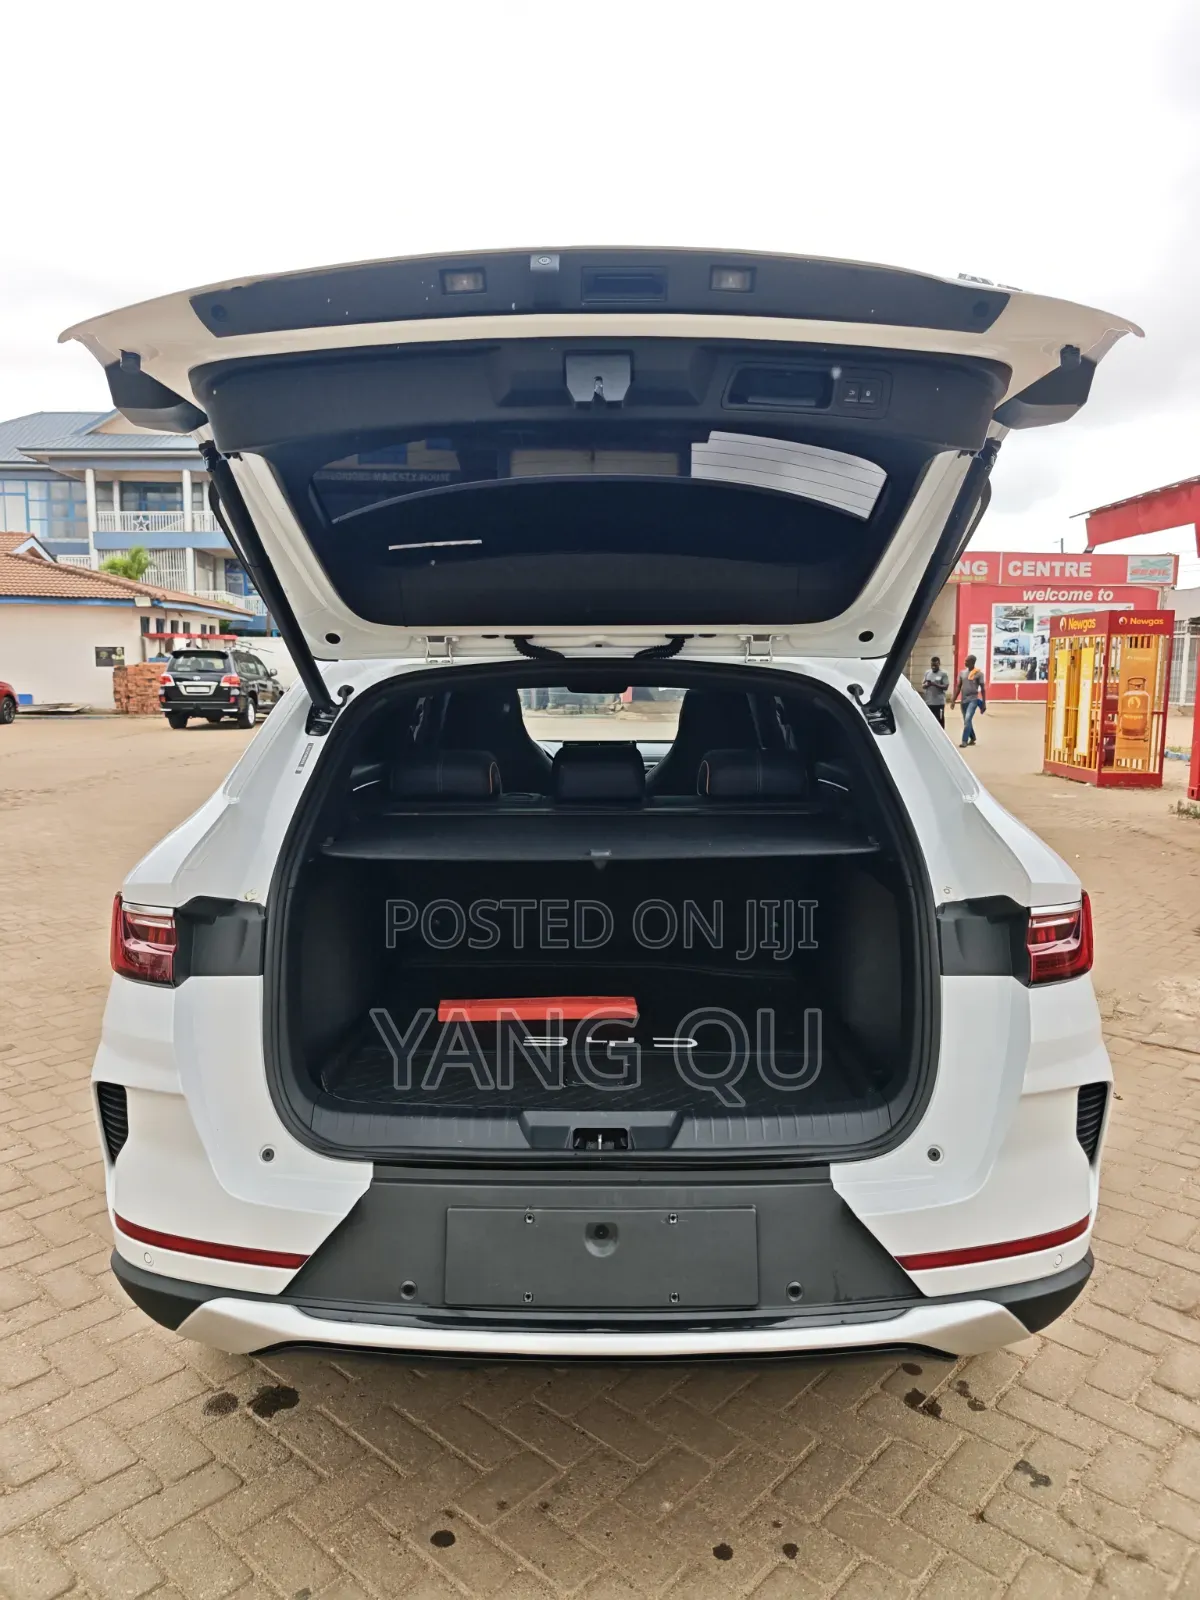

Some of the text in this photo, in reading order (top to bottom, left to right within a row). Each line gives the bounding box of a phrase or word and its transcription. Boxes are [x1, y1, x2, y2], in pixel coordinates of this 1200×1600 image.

[1008, 560, 1092, 578] CENTRE
[1022, 587, 1114, 602] welcome to
[1068, 616, 1097, 633] Newgas
[1129, 617, 1164, 628] Newgas
